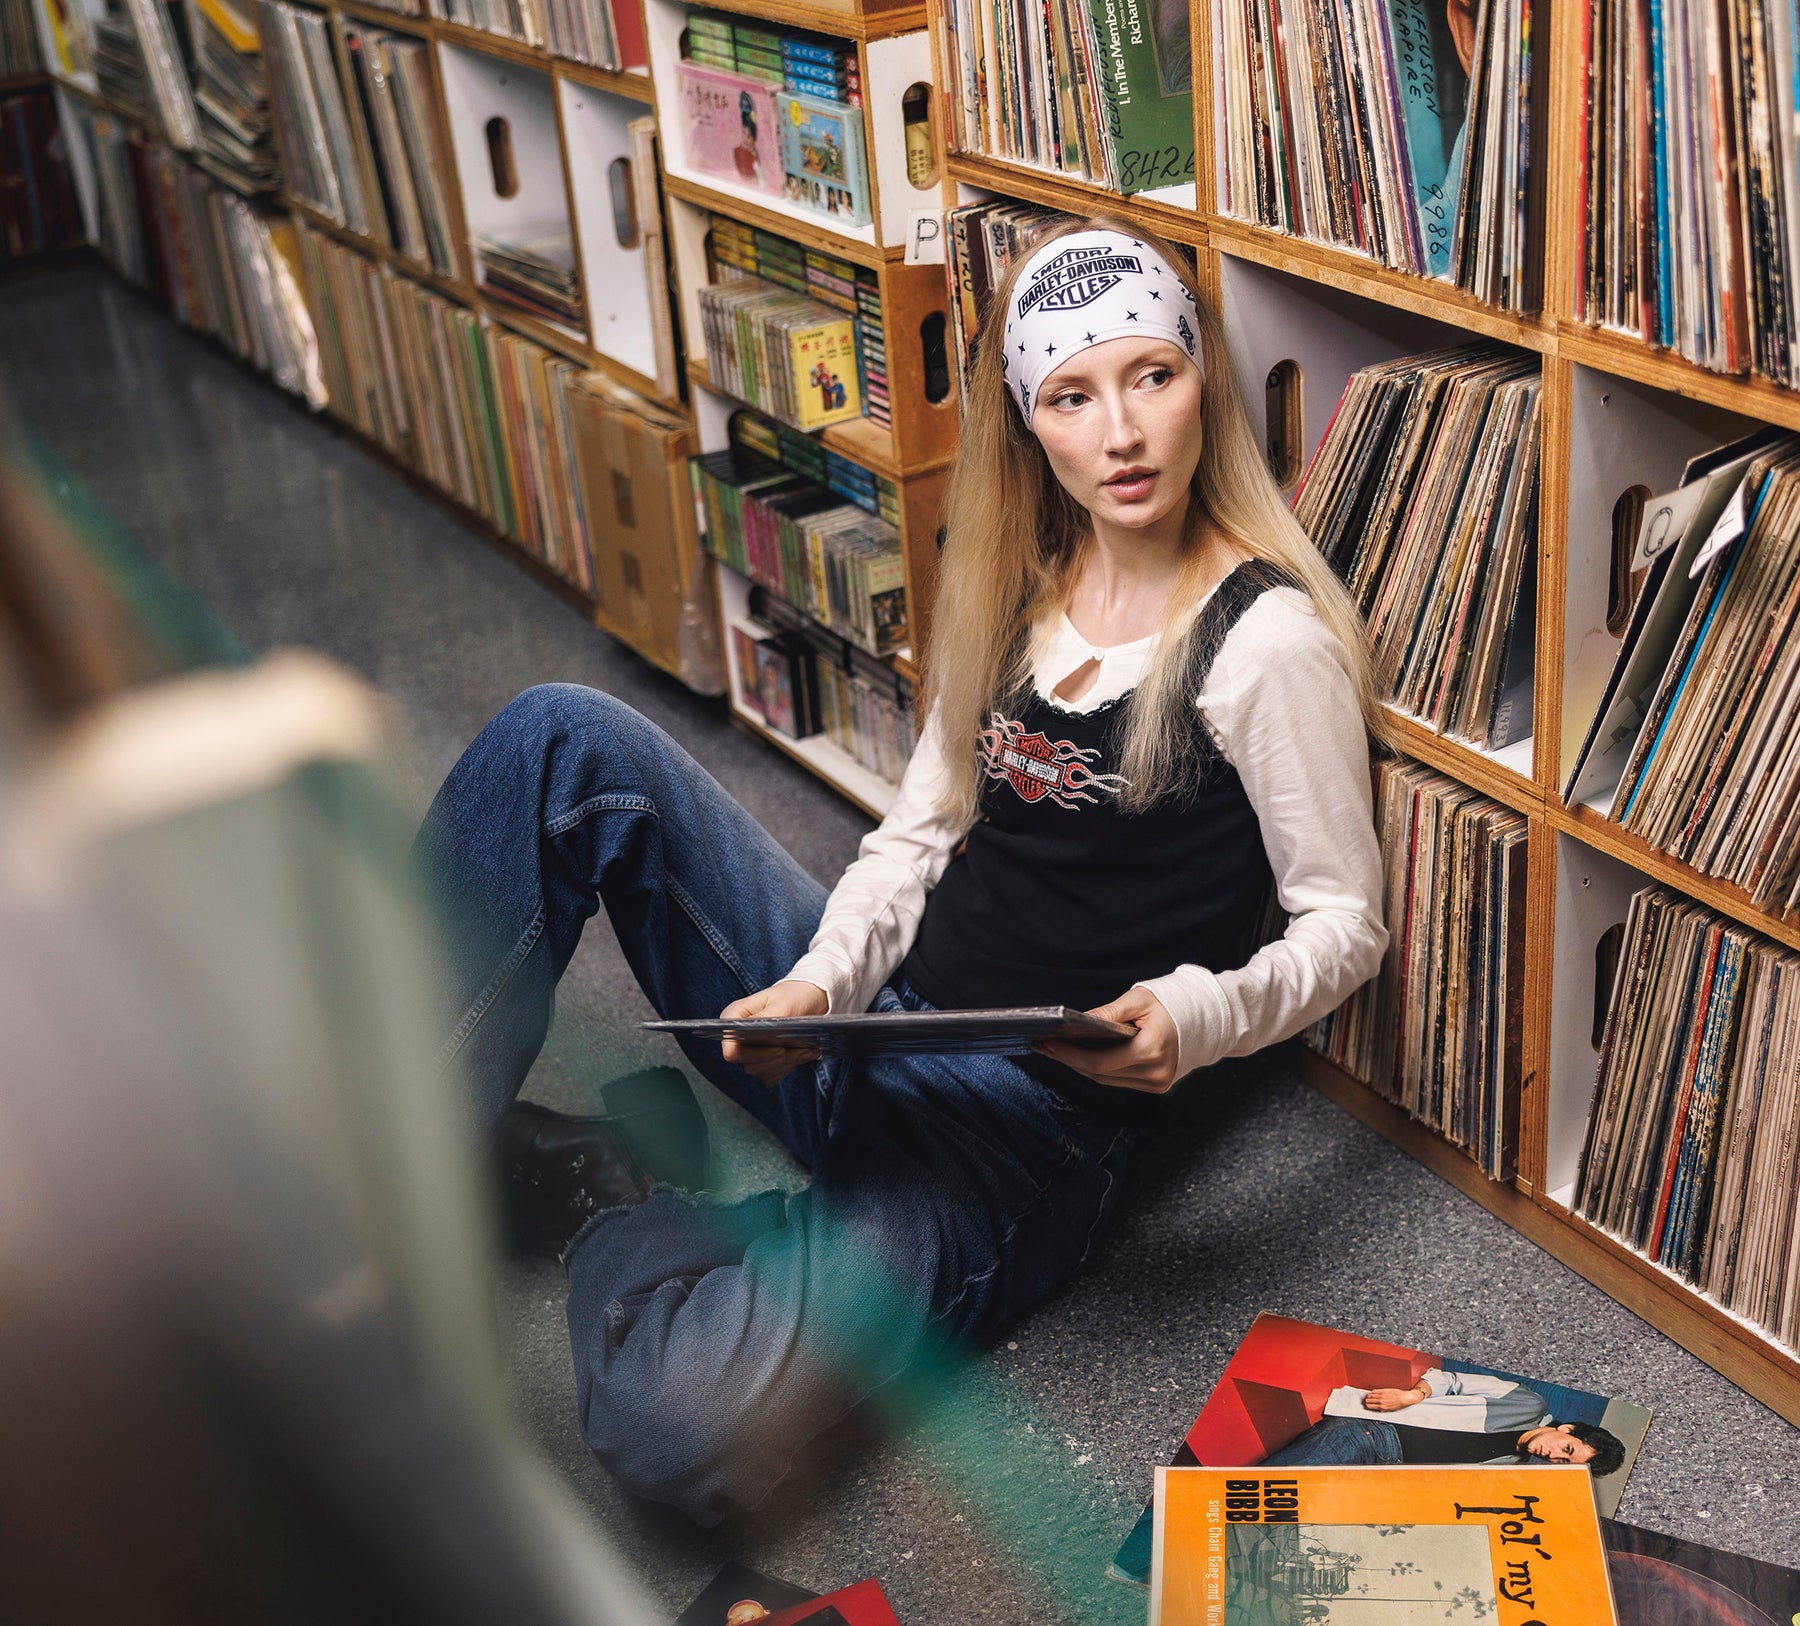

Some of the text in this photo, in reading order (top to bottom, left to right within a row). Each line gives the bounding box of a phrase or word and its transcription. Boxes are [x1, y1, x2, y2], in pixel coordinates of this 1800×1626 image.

[1104, 0, 1124, 58] Member
[1113, 60, 1127, 83] The
[1117, 82, 1130, 96] In
[1422, 183, 1450, 255] 9986
[914, 218, 940, 260] P
[1040, 250, 1103, 277] MOTOR
[1021, 257, 1136, 313] HARLEY-DAVIDSON
[1046, 275, 1112, 307] CYCLES
[1643, 506, 1673, 558] Q
[1002, 748, 1060, 784] HARLEY-DAVIDSON
[1020, 738, 1051, 761] MOTOR
[1011, 771, 1046, 796] CYCLES
[1205, 1499, 1223, 1523] sings
[1226, 1480, 1260, 1522] BIBB
[1263, 1480, 1299, 1522] LEON
[1208, 1527, 1223, 1552] Chain
[1453, 1494, 1552, 1560] Tol'
[1205, 1555, 1223, 1579] Gang
[1207, 1583, 1222, 1601] and
[1499, 1561, 1535, 1610] my
